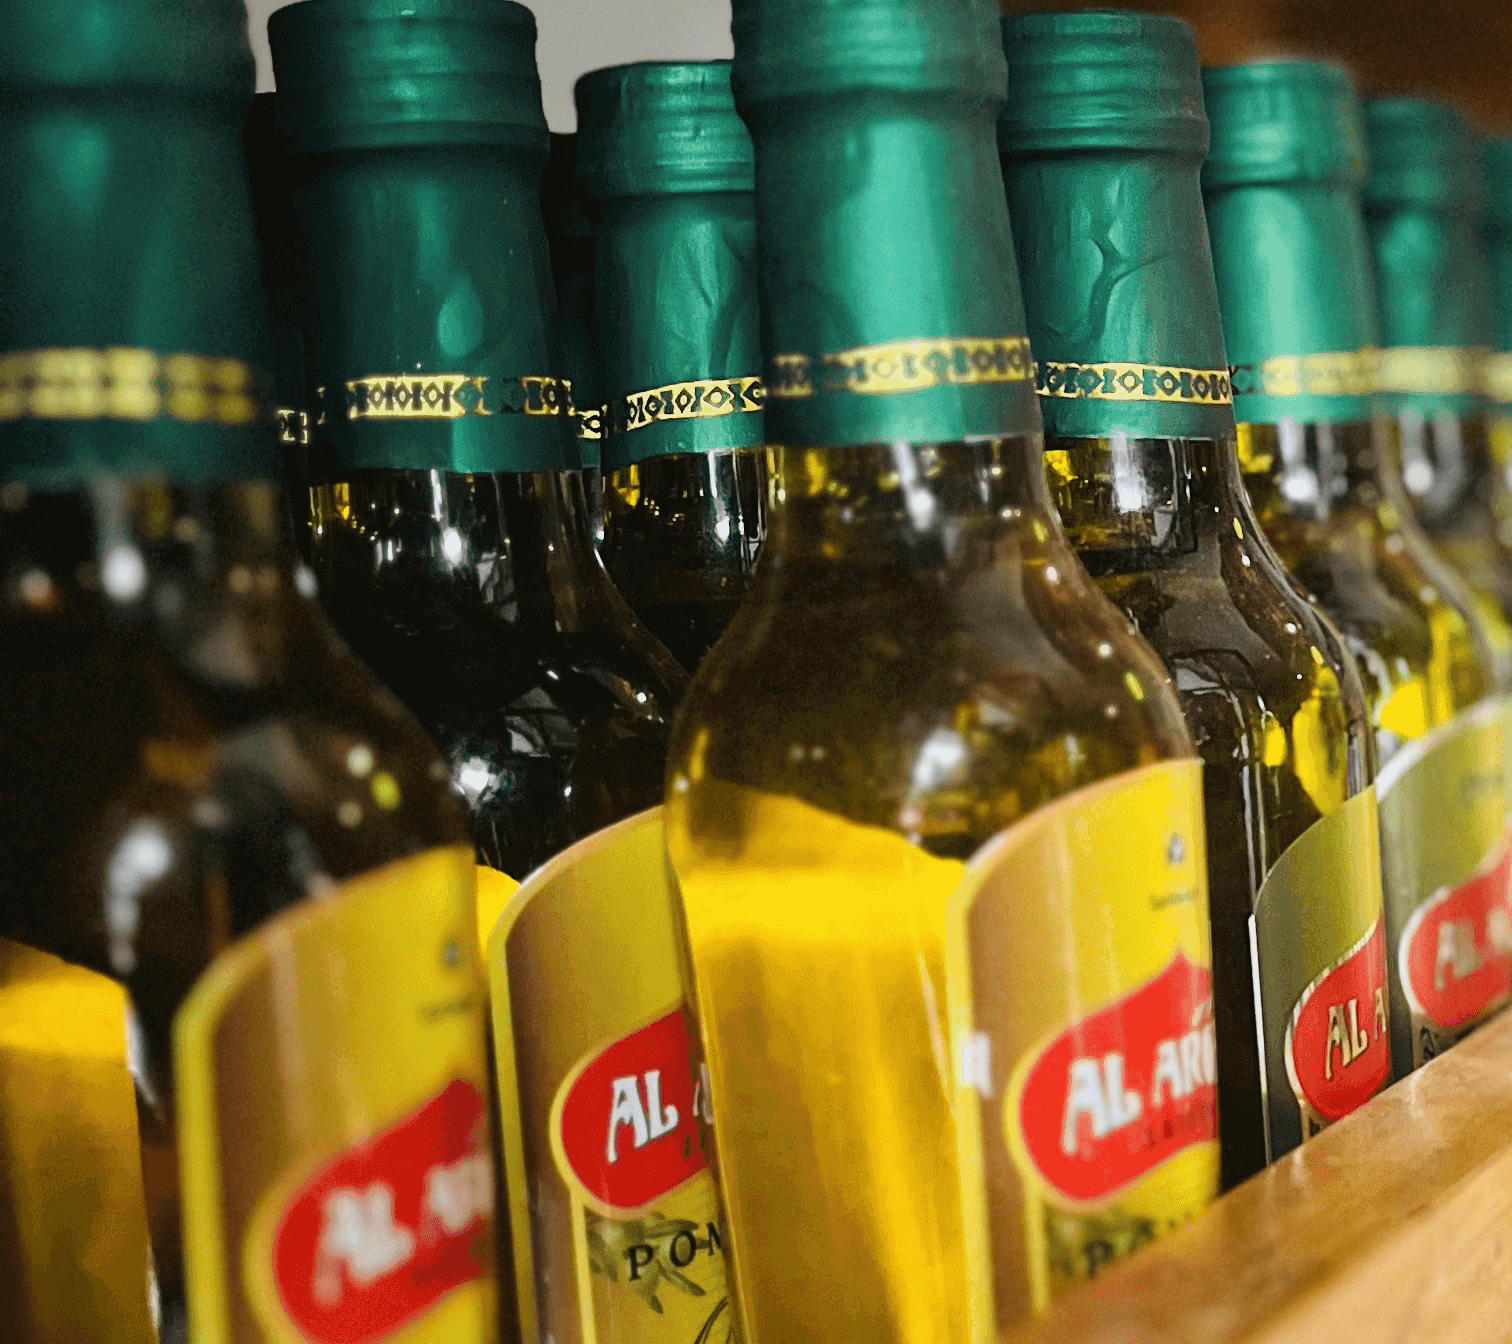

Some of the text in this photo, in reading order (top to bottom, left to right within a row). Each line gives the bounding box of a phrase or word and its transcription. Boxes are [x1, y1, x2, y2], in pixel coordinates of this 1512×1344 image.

[1325, 998, 1368, 1081] AL
[606, 1068, 679, 1164] AL
[1062, 1052, 1142, 1154] AL
[312, 1180, 416, 1307] AL
